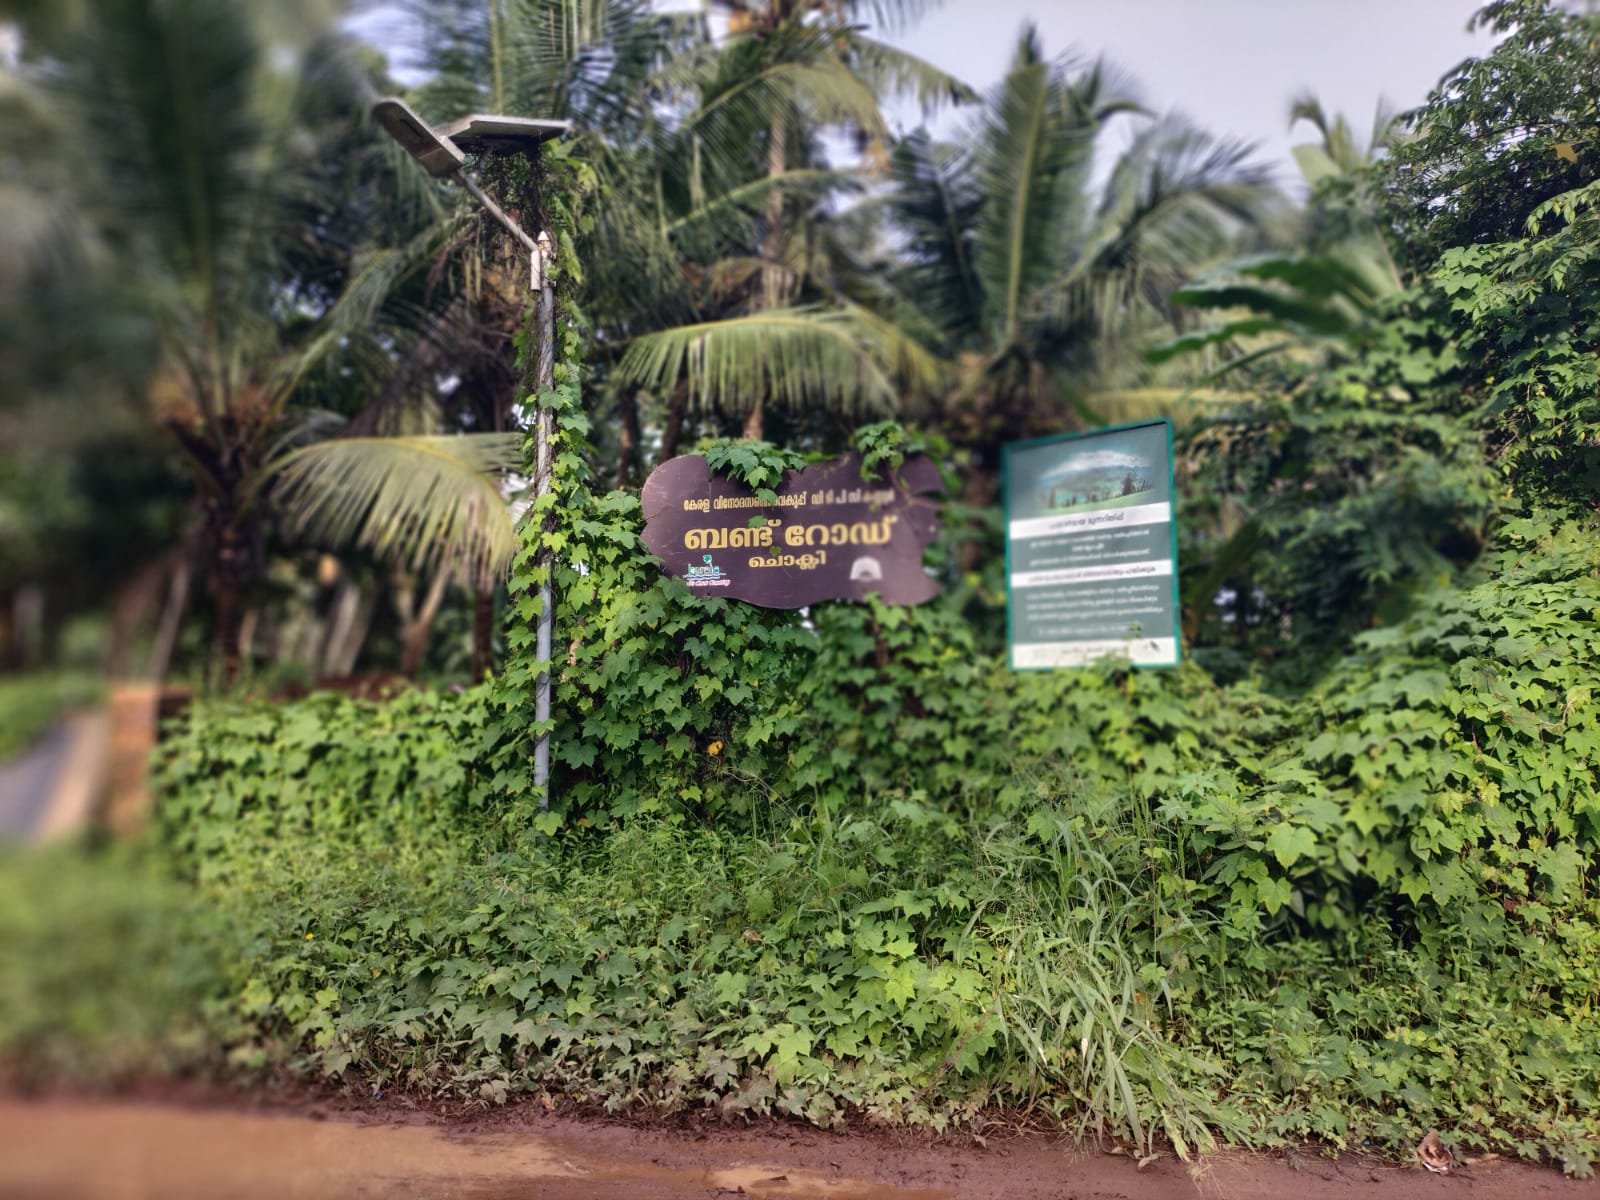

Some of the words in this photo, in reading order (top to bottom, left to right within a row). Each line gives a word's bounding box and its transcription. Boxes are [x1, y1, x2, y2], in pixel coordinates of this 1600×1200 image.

[683, 498, 710, 513] കേരള
[684, 519, 782, 548] ബണ്ട്
[784, 515, 899, 546] റോഡ്
[748, 550, 827, 570] ചൊക്ലി
